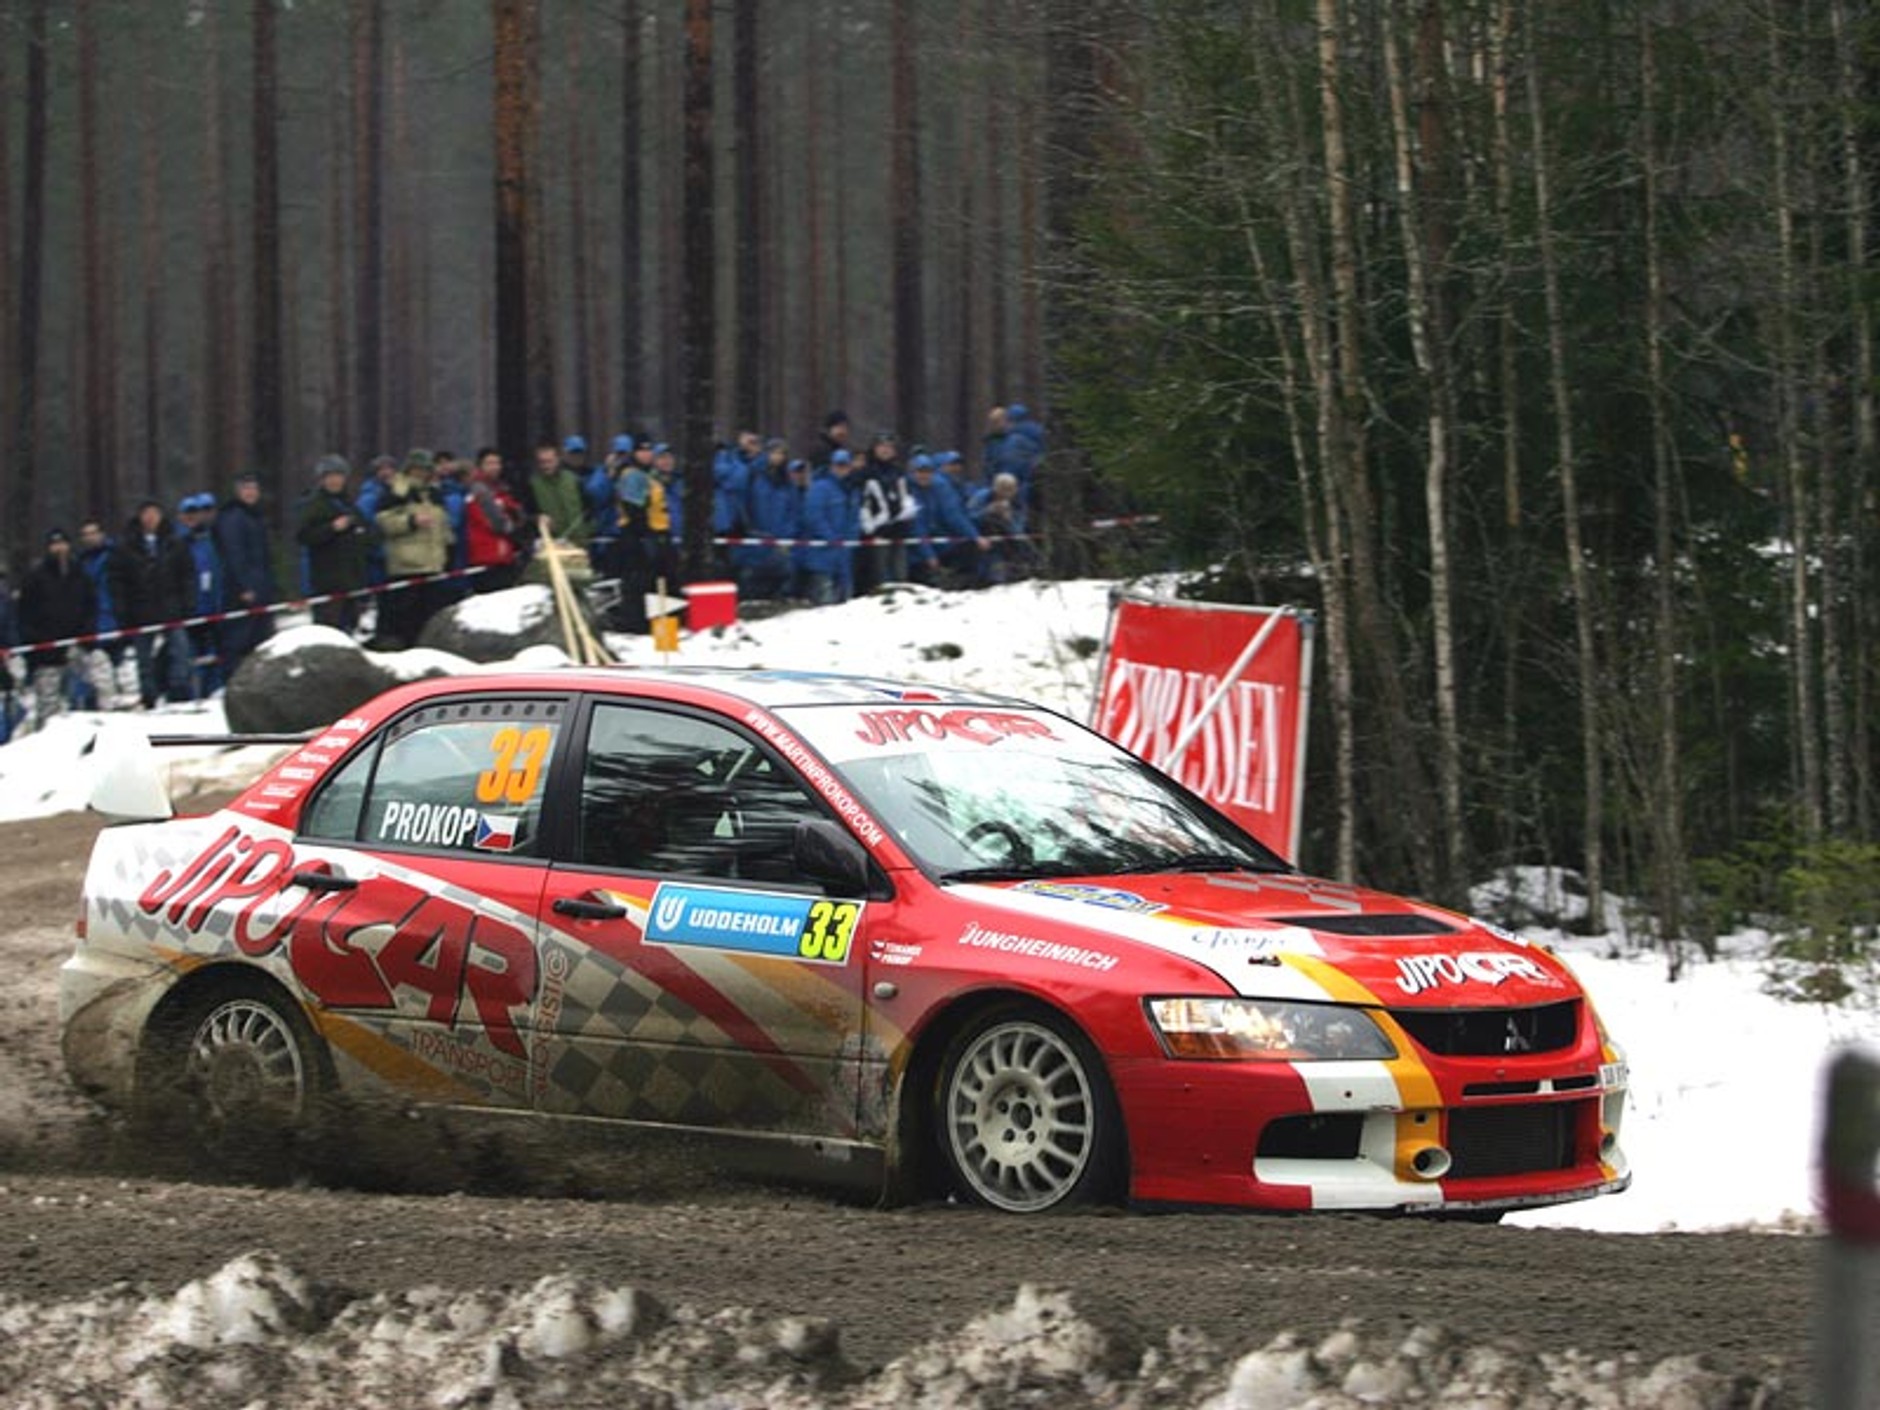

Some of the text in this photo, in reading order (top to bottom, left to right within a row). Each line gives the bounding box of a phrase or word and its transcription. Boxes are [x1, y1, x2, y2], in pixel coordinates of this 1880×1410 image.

[476, 727, 551, 805] 33
[380, 802, 477, 846] PROKOP
[689, 908, 800, 937] UDDEHOLM
[800, 901, 857, 961] 33
[958, 921, 1119, 971] JUNGHEINRICH
